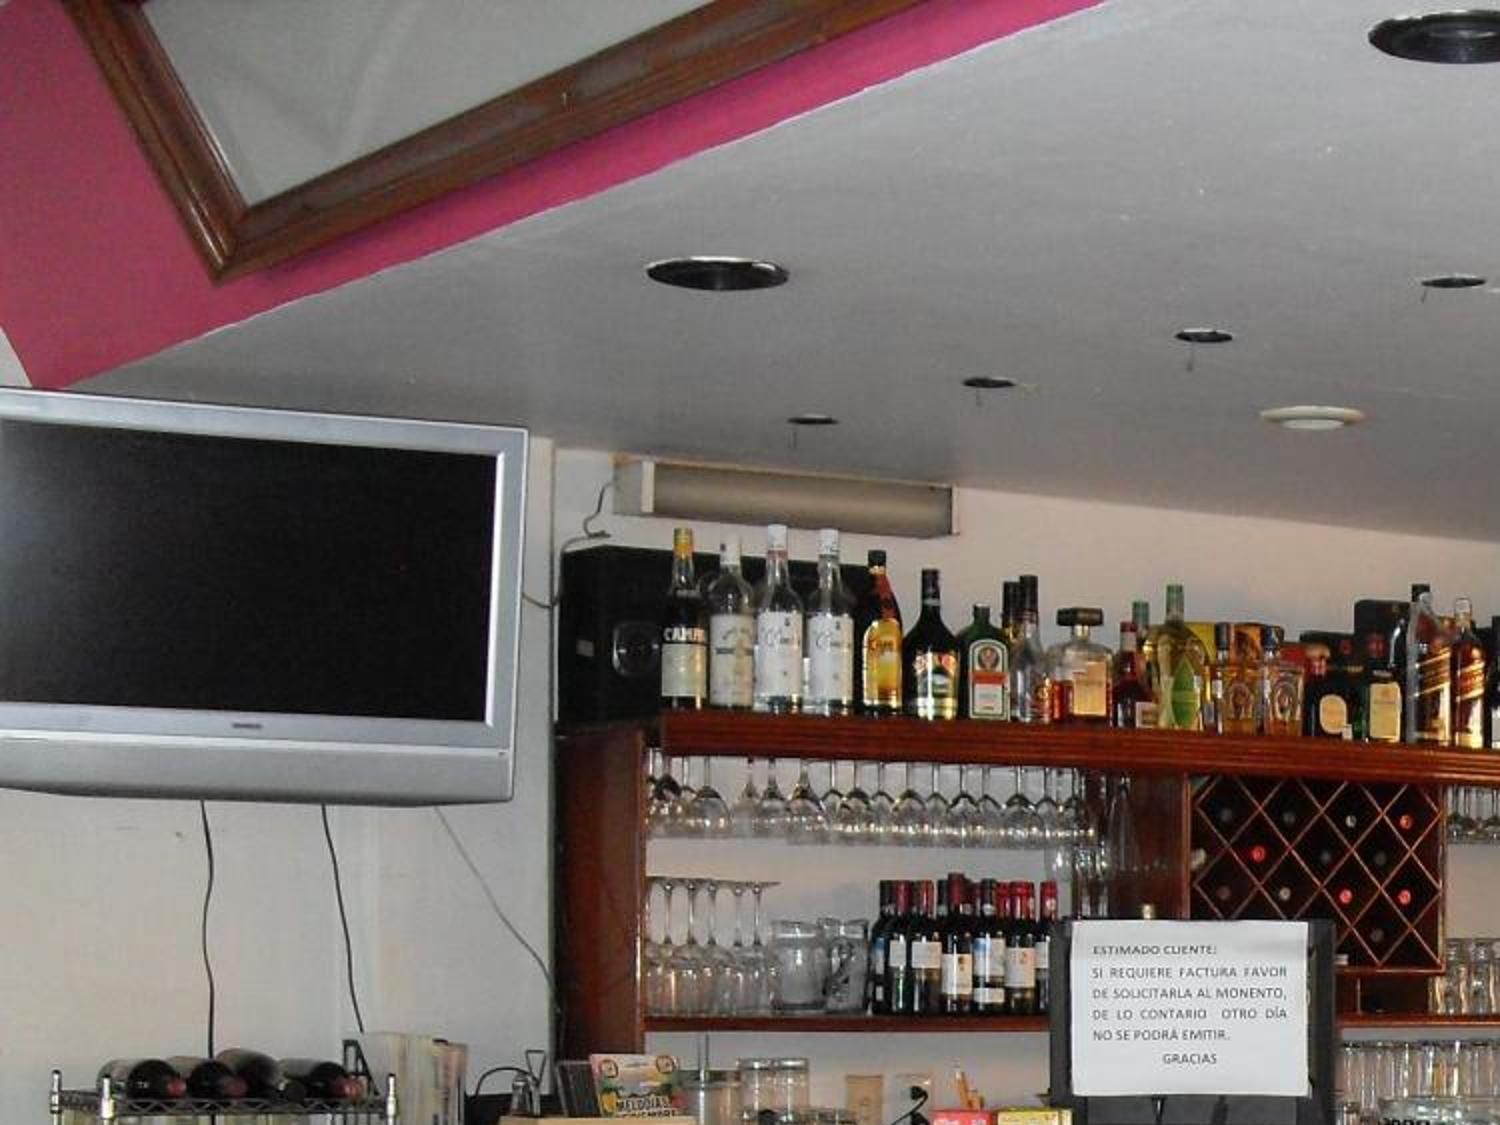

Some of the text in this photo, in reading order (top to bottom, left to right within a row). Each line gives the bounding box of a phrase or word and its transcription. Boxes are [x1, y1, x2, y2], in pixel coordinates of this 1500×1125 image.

[1093, 945, 1217, 955] ESTIMADO CLIENTE:
[1092, 966, 1287, 979] SI REQUIERE FACTURA FAVOR
[1093, 988, 1108, 999] DE
[1112, 987, 1192, 999] SOLICITARLA
[1197, 987, 1211, 999] AL
[1093, 1006, 1287, 1020] DE LO CONTARIO OTRO DÍA
[1093, 1030, 1112, 1040] NO
[1115, 1030, 1130, 1040] SE
[1182, 1029, 1231, 1040] EMITIR.
[1162, 1053, 1217, 1064] GRACIAS
